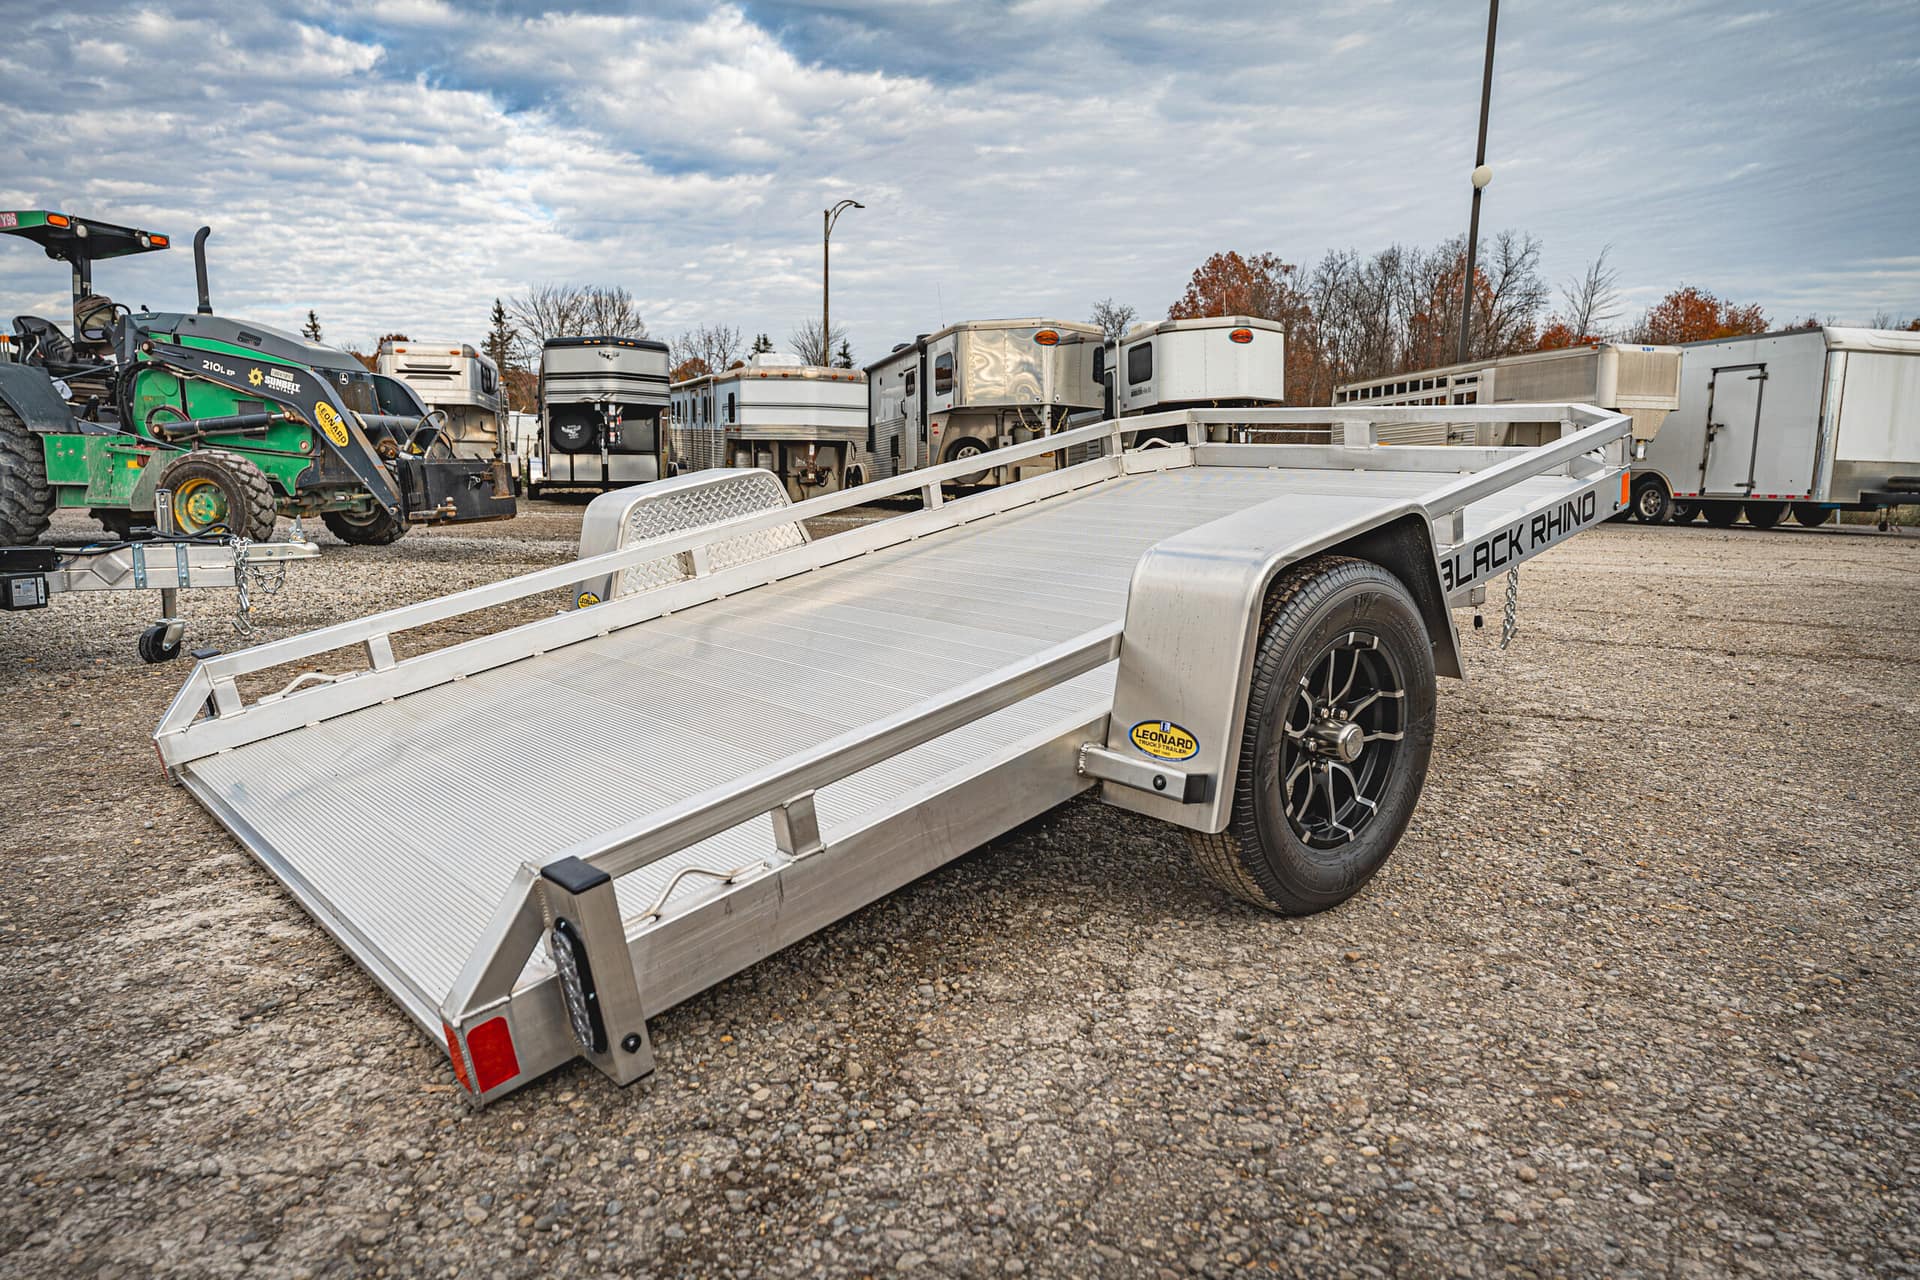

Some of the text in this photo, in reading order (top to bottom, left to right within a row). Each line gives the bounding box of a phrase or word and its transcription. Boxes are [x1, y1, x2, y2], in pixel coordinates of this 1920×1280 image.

[264, 375, 300, 393] SUNBELT
[318, 403, 346, 443] LEONARD
[1441, 490, 1595, 592] BLACK RHINO
[1135, 728, 1193, 750] LEONARD
[1162, 744, 1187, 754] TRAILER
